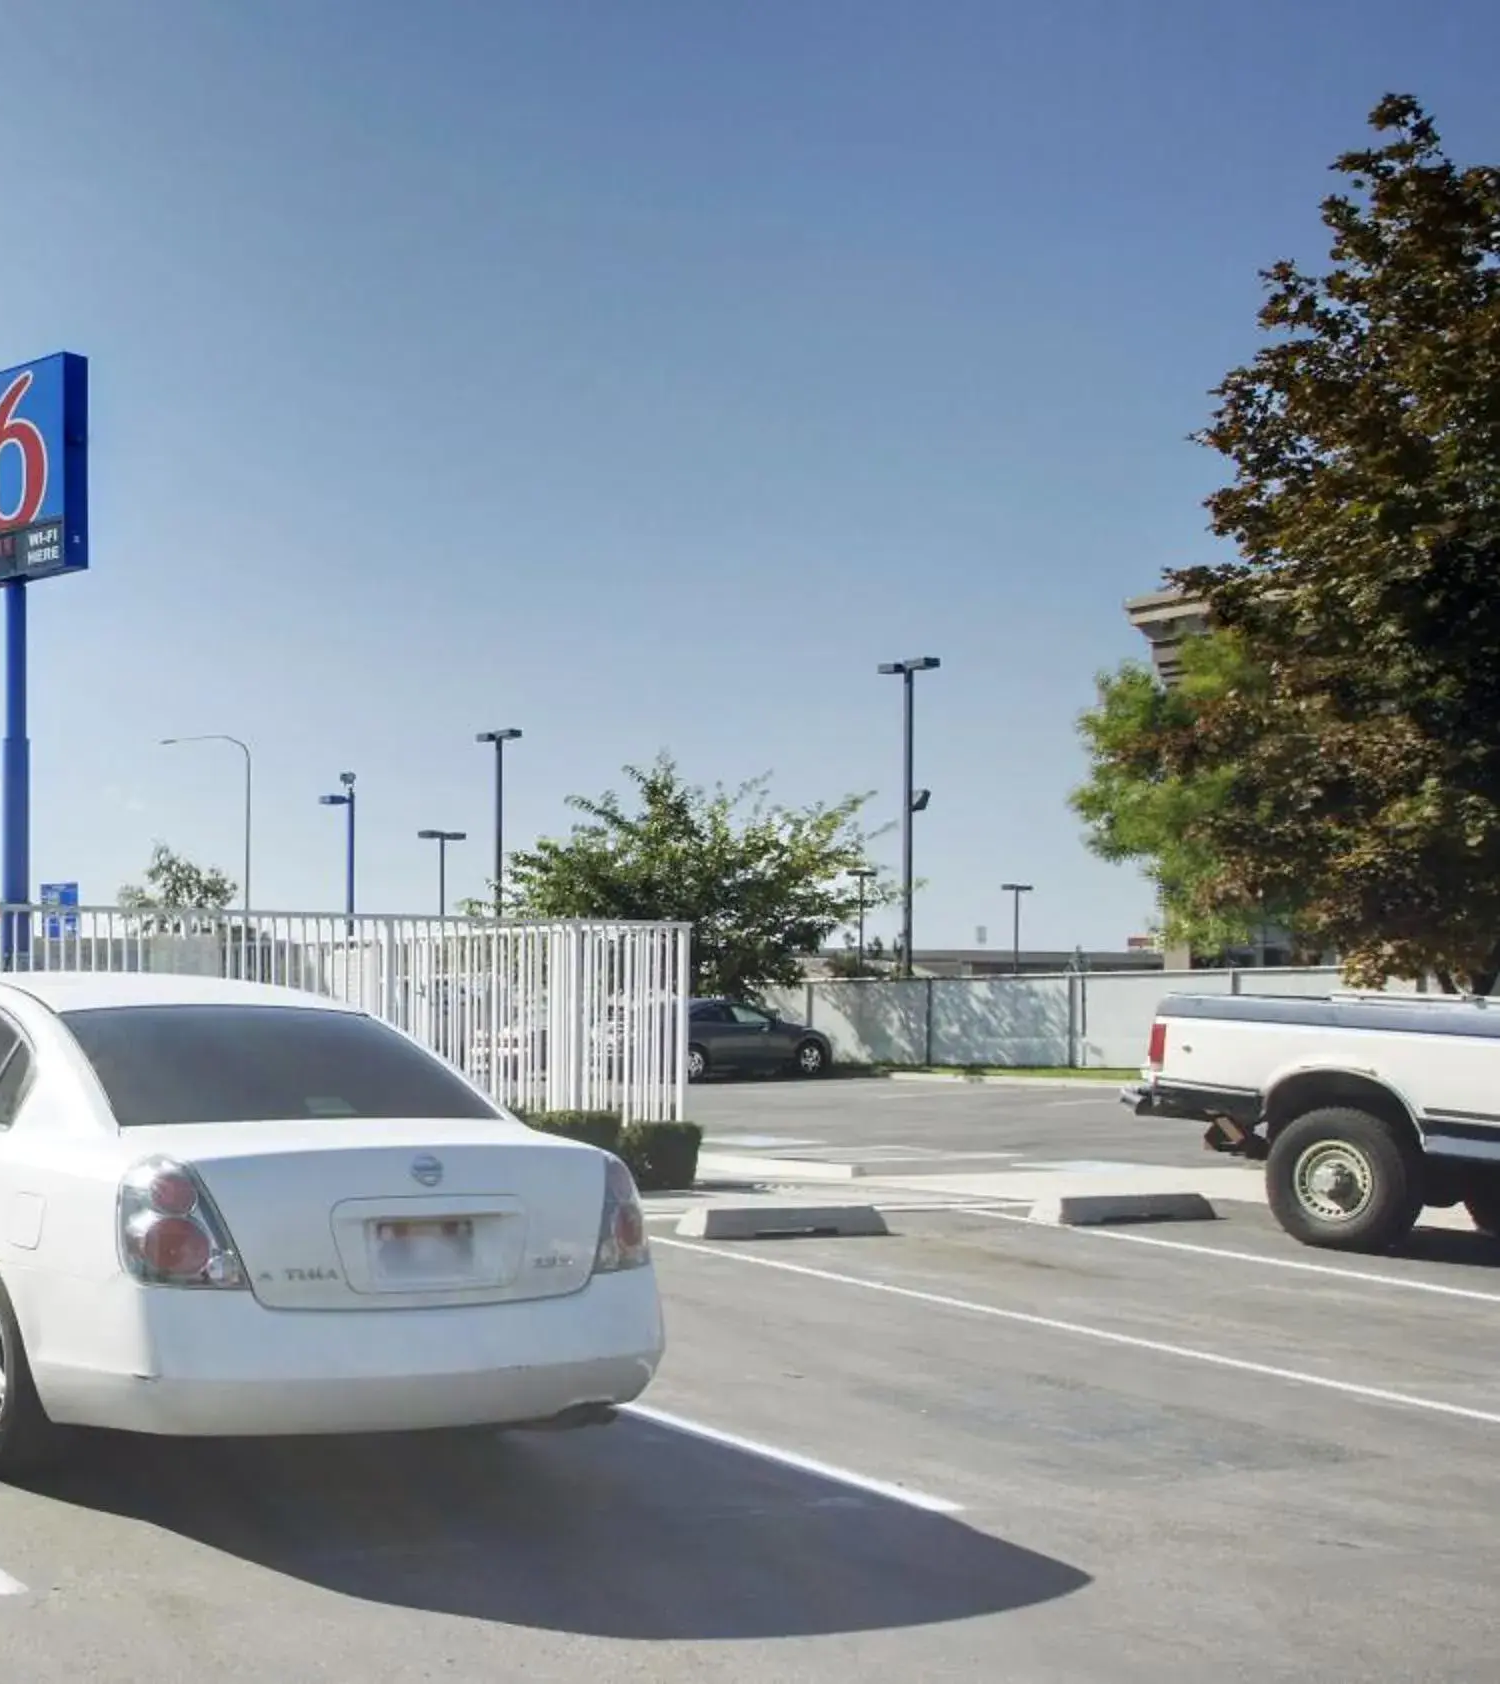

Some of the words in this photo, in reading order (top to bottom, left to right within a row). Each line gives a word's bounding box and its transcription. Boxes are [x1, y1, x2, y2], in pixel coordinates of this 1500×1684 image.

[28, 528, 58, 547] WI-FI
[28, 546, 59, 565] HERE
[258, 1266, 339, 1281] ATIMA
